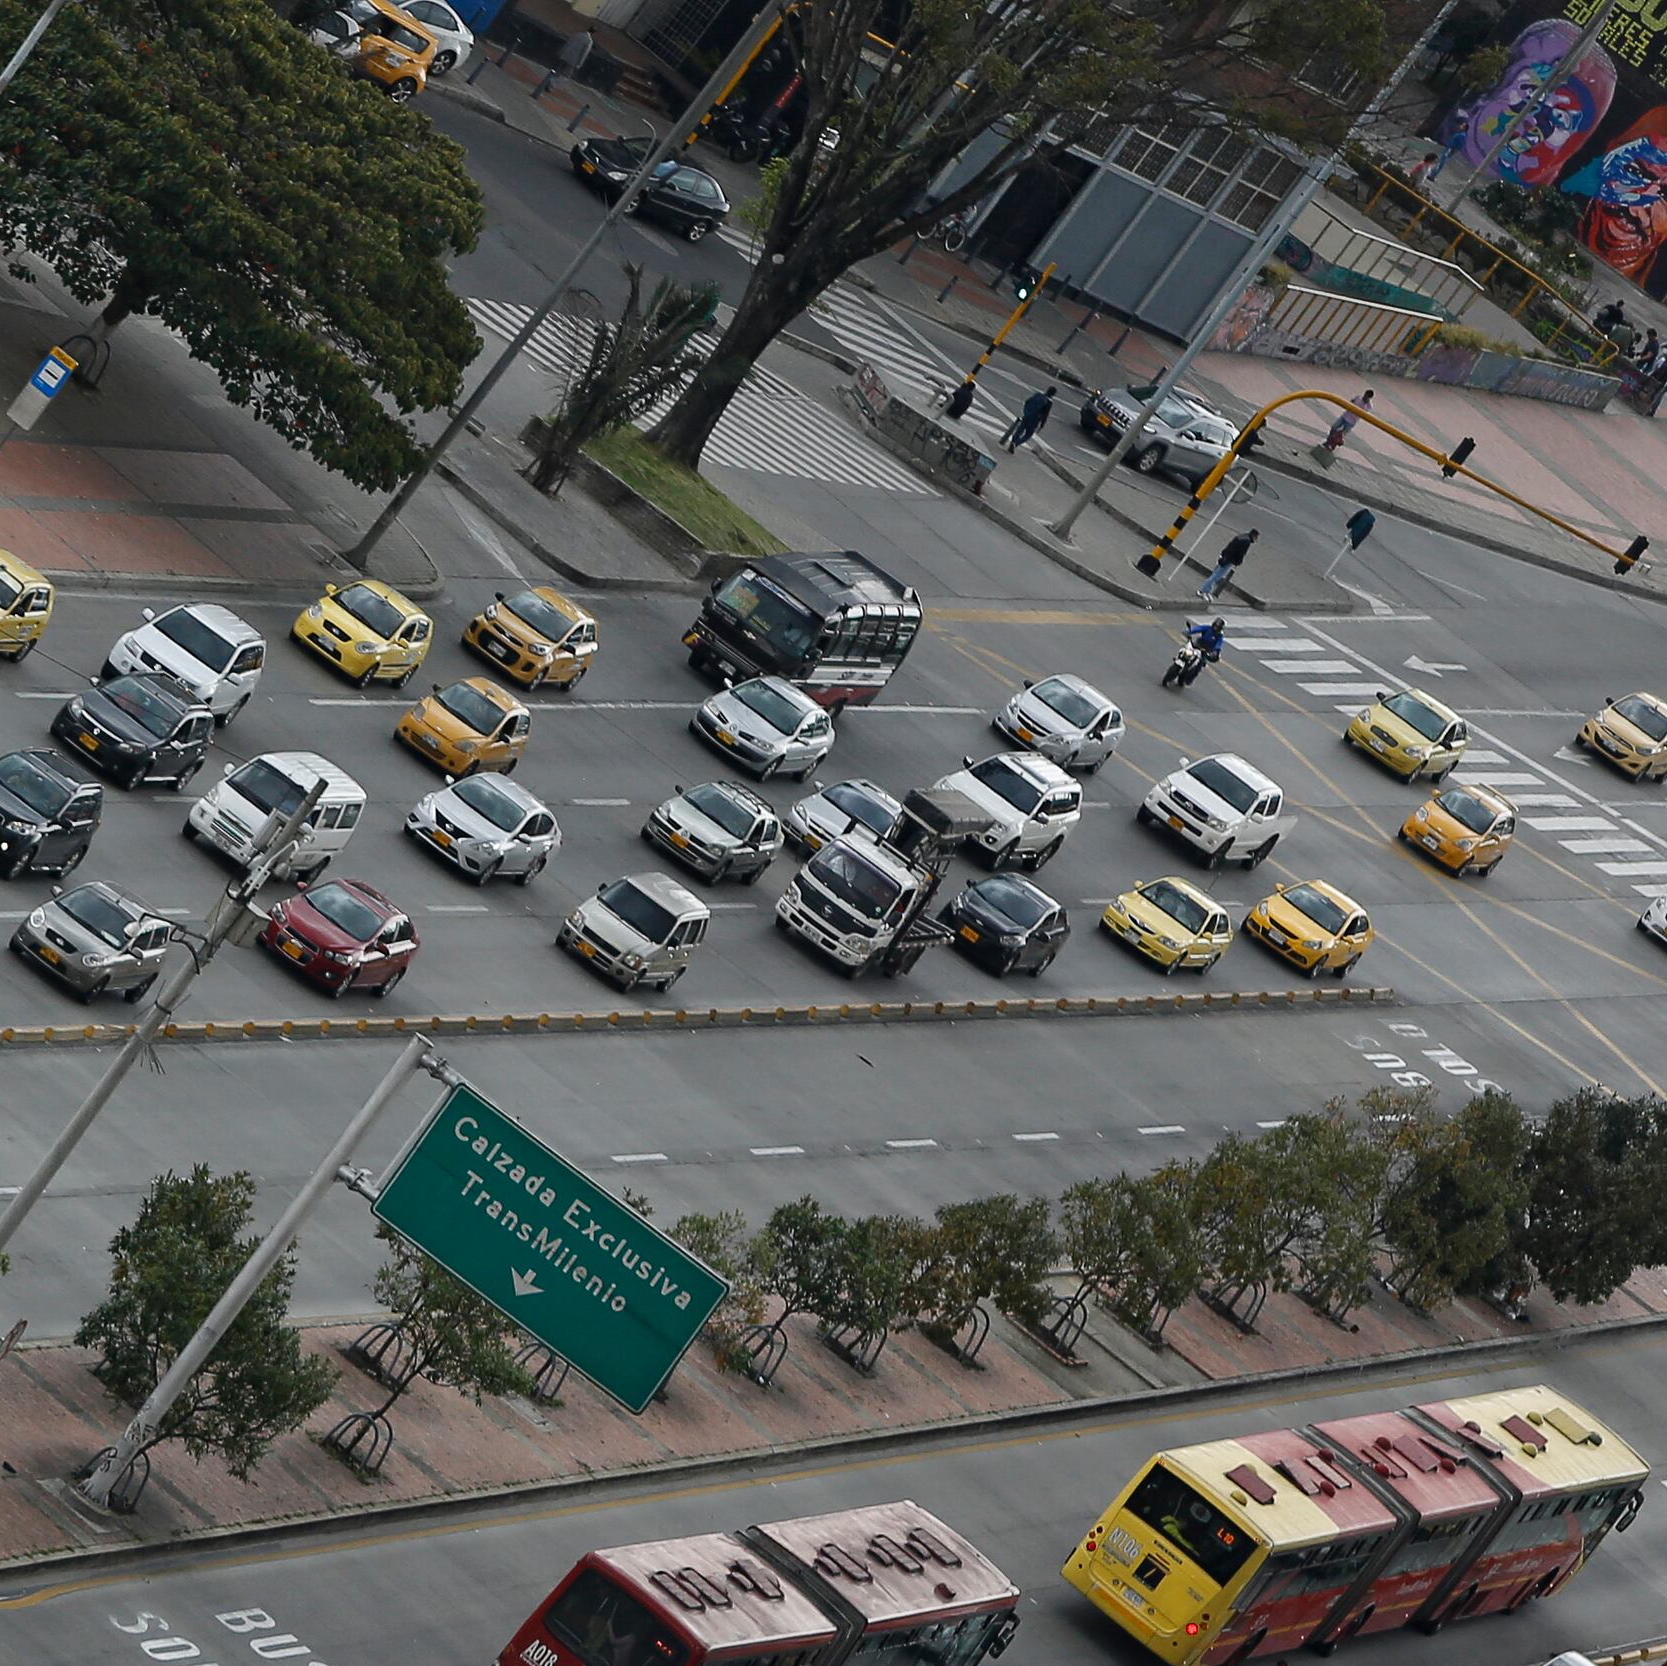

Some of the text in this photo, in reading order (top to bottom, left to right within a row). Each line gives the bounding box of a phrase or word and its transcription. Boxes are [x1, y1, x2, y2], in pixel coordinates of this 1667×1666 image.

[1562, 0, 1647, 67] SOALES
[454, 1117, 693, 1311] Calzada Exclusiva
[460, 1171, 626, 1313] TransMilenio
